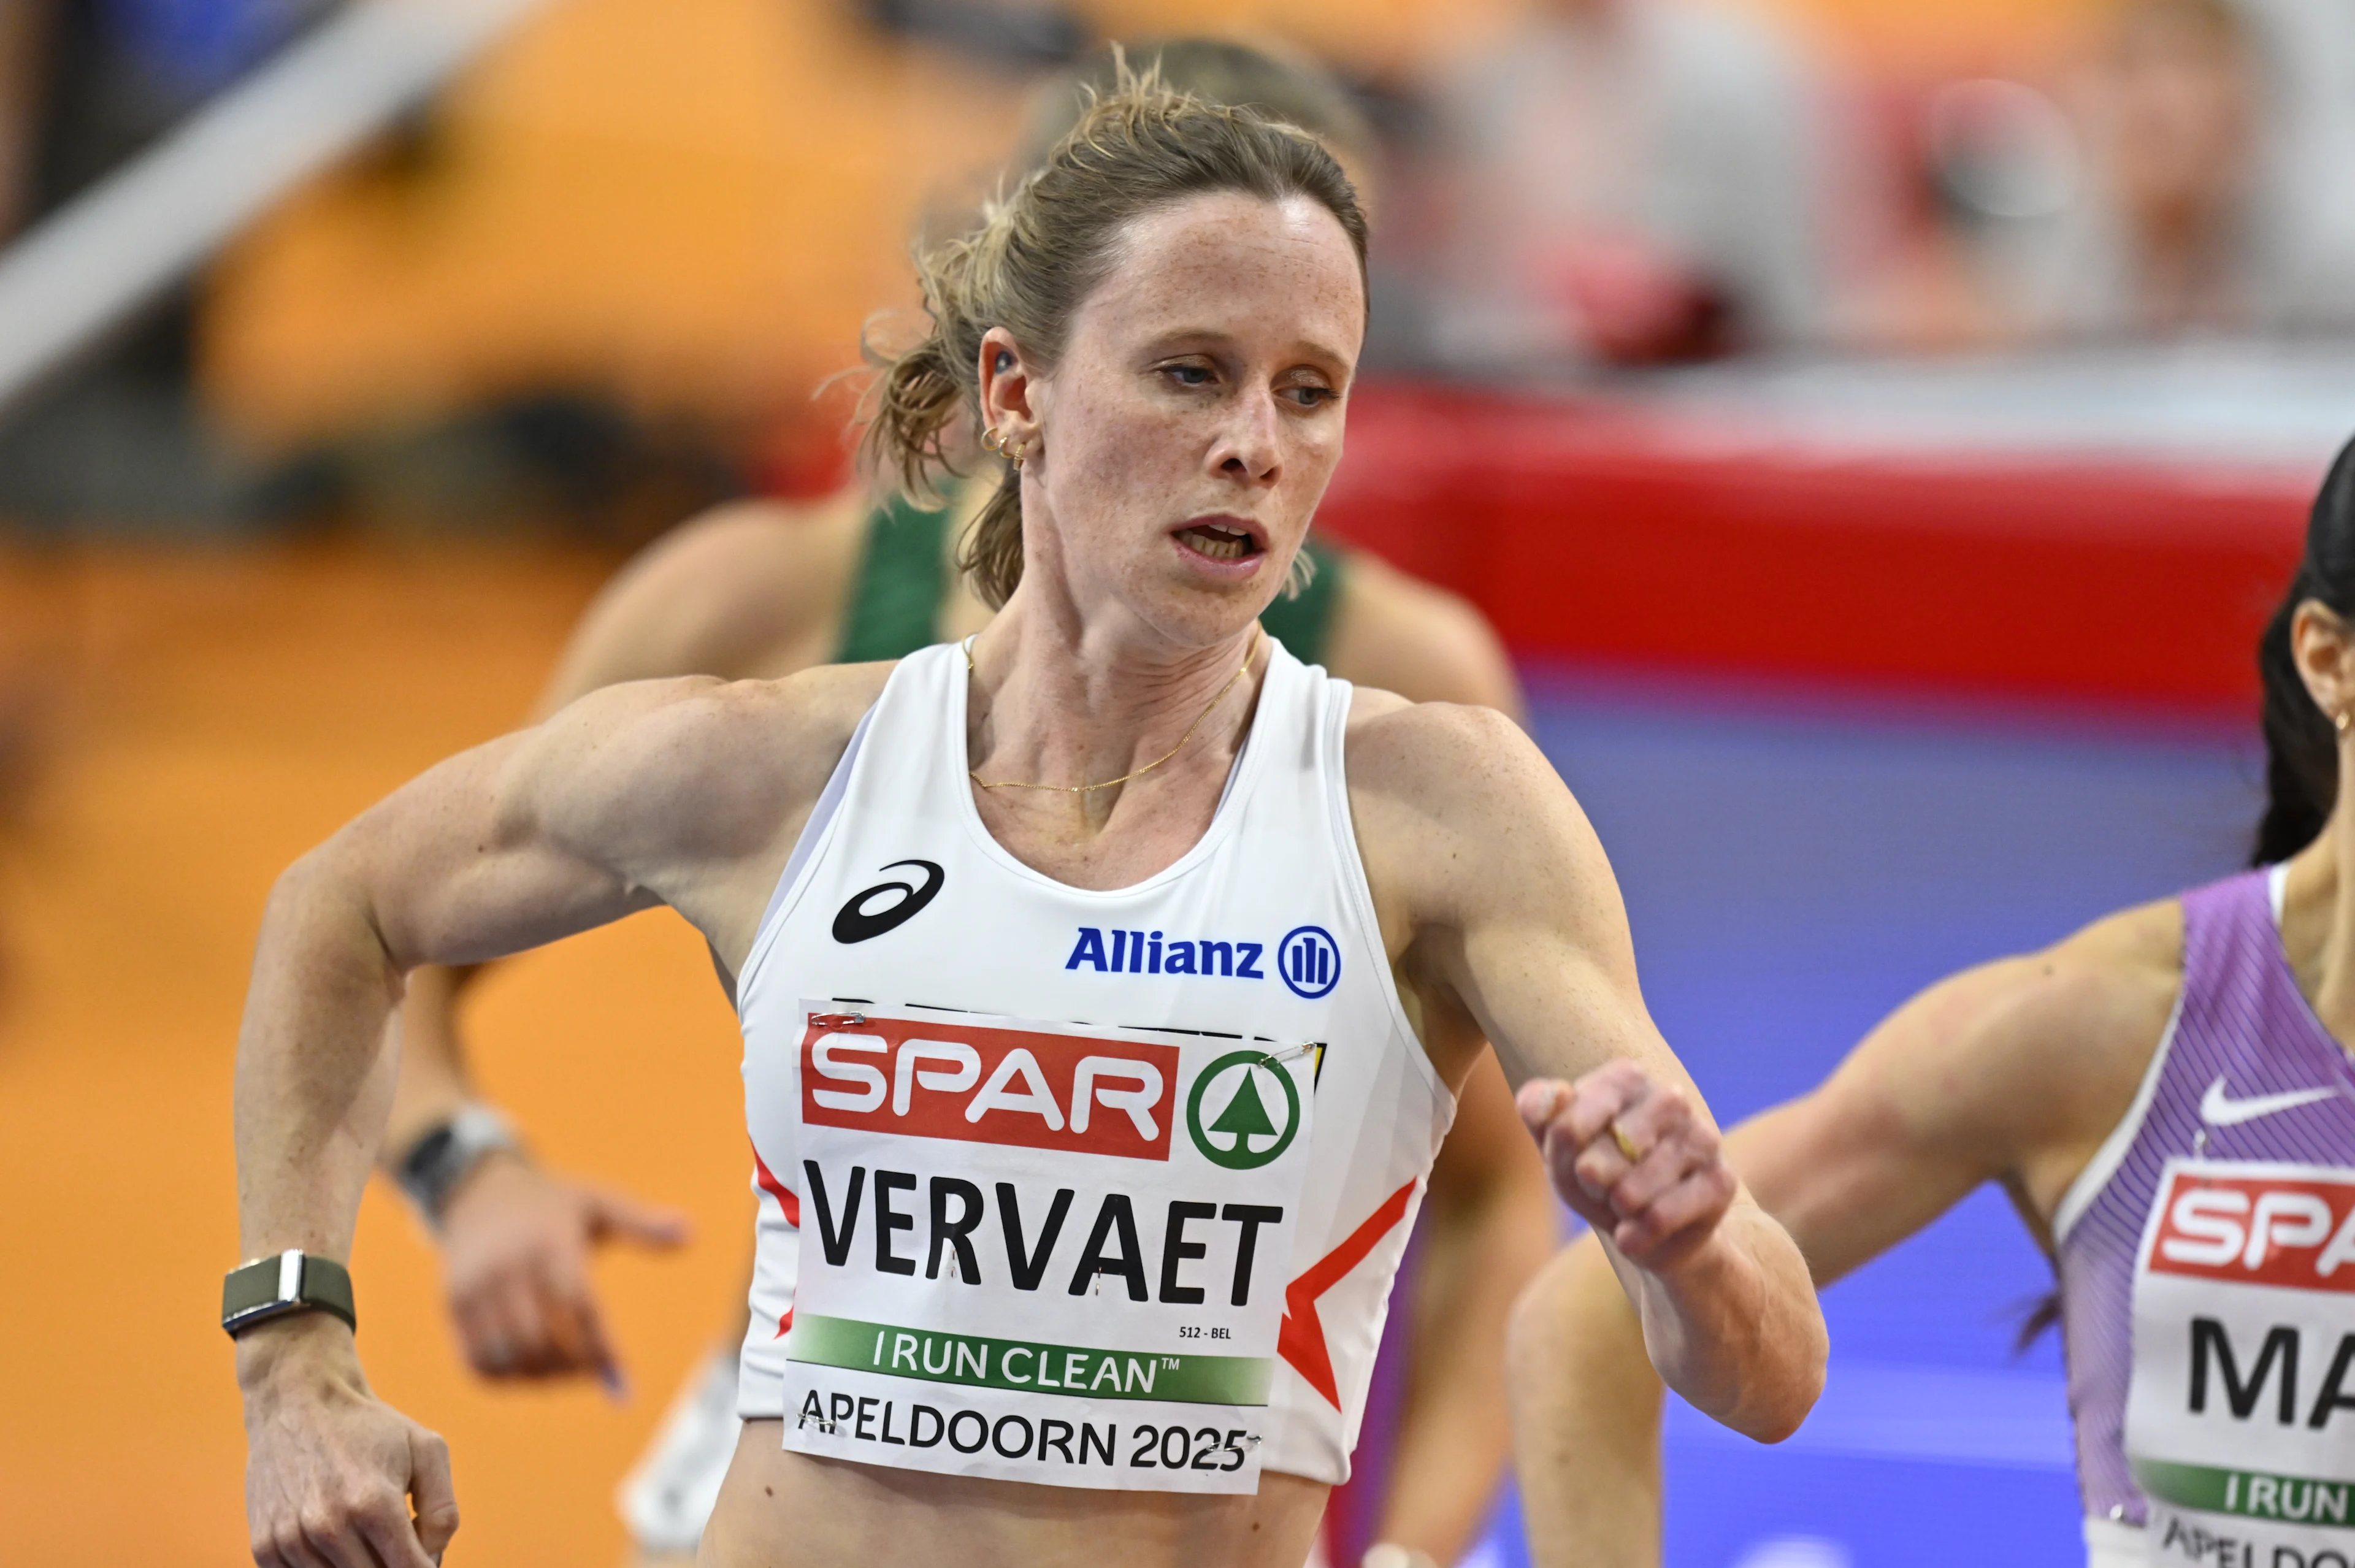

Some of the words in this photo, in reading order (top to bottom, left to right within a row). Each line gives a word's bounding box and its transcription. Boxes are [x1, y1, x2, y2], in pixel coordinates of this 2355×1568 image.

[1065, 927, 1264, 980] Allianz
[811, 1033, 1164, 1142] SPAR
[803, 1160, 1284, 1307] VERVAET
[872, 1331, 886, 1366] I
[892, 1334, 987, 1380] RUN
[1179, 1326, 1201, 1339] 512
[1211, 1327, 1231, 1340] BEL
[798, 1389, 1117, 1467] APELDOORN
[1130, 1424, 1247, 1472] 2025
[2224, 1473, 2239, 1511] I
[2246, 1475, 2349, 1523] RUN
